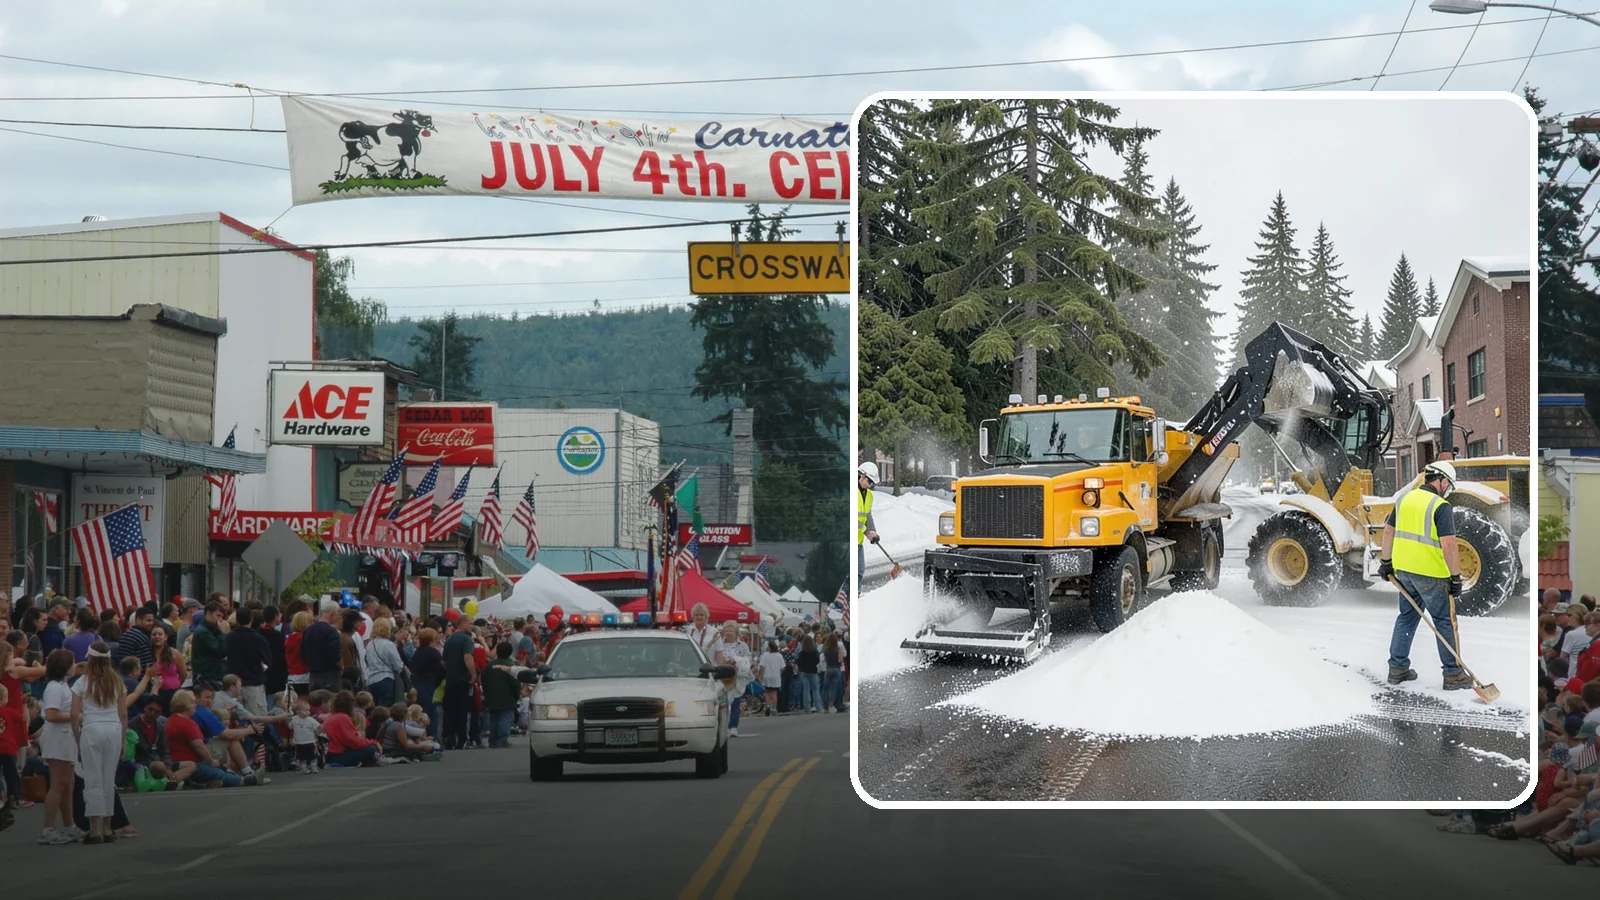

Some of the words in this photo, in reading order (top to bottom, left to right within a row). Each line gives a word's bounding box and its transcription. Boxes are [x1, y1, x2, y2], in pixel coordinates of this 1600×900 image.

[481, 141, 604, 193] JULY
[632, 150, 746, 197] 4th.
[696, 254, 850, 281] CROSSWA
[283, 380, 373, 419] ACE
[405, 409, 452, 421] CEDAR
[461, 409, 485, 421] LOG
[283, 421, 371, 437] Hardware
[354, 467, 384, 480] Simpl
[83, 485, 93, 494] St.
[96, 485, 124, 495] Vincent
[126, 486, 136, 495] de
[138, 486, 155, 495] Paul
[81, 503, 154, 522] THT
[688, 527, 741, 535] CRNATION
[699, 535, 730, 543] GLASS
